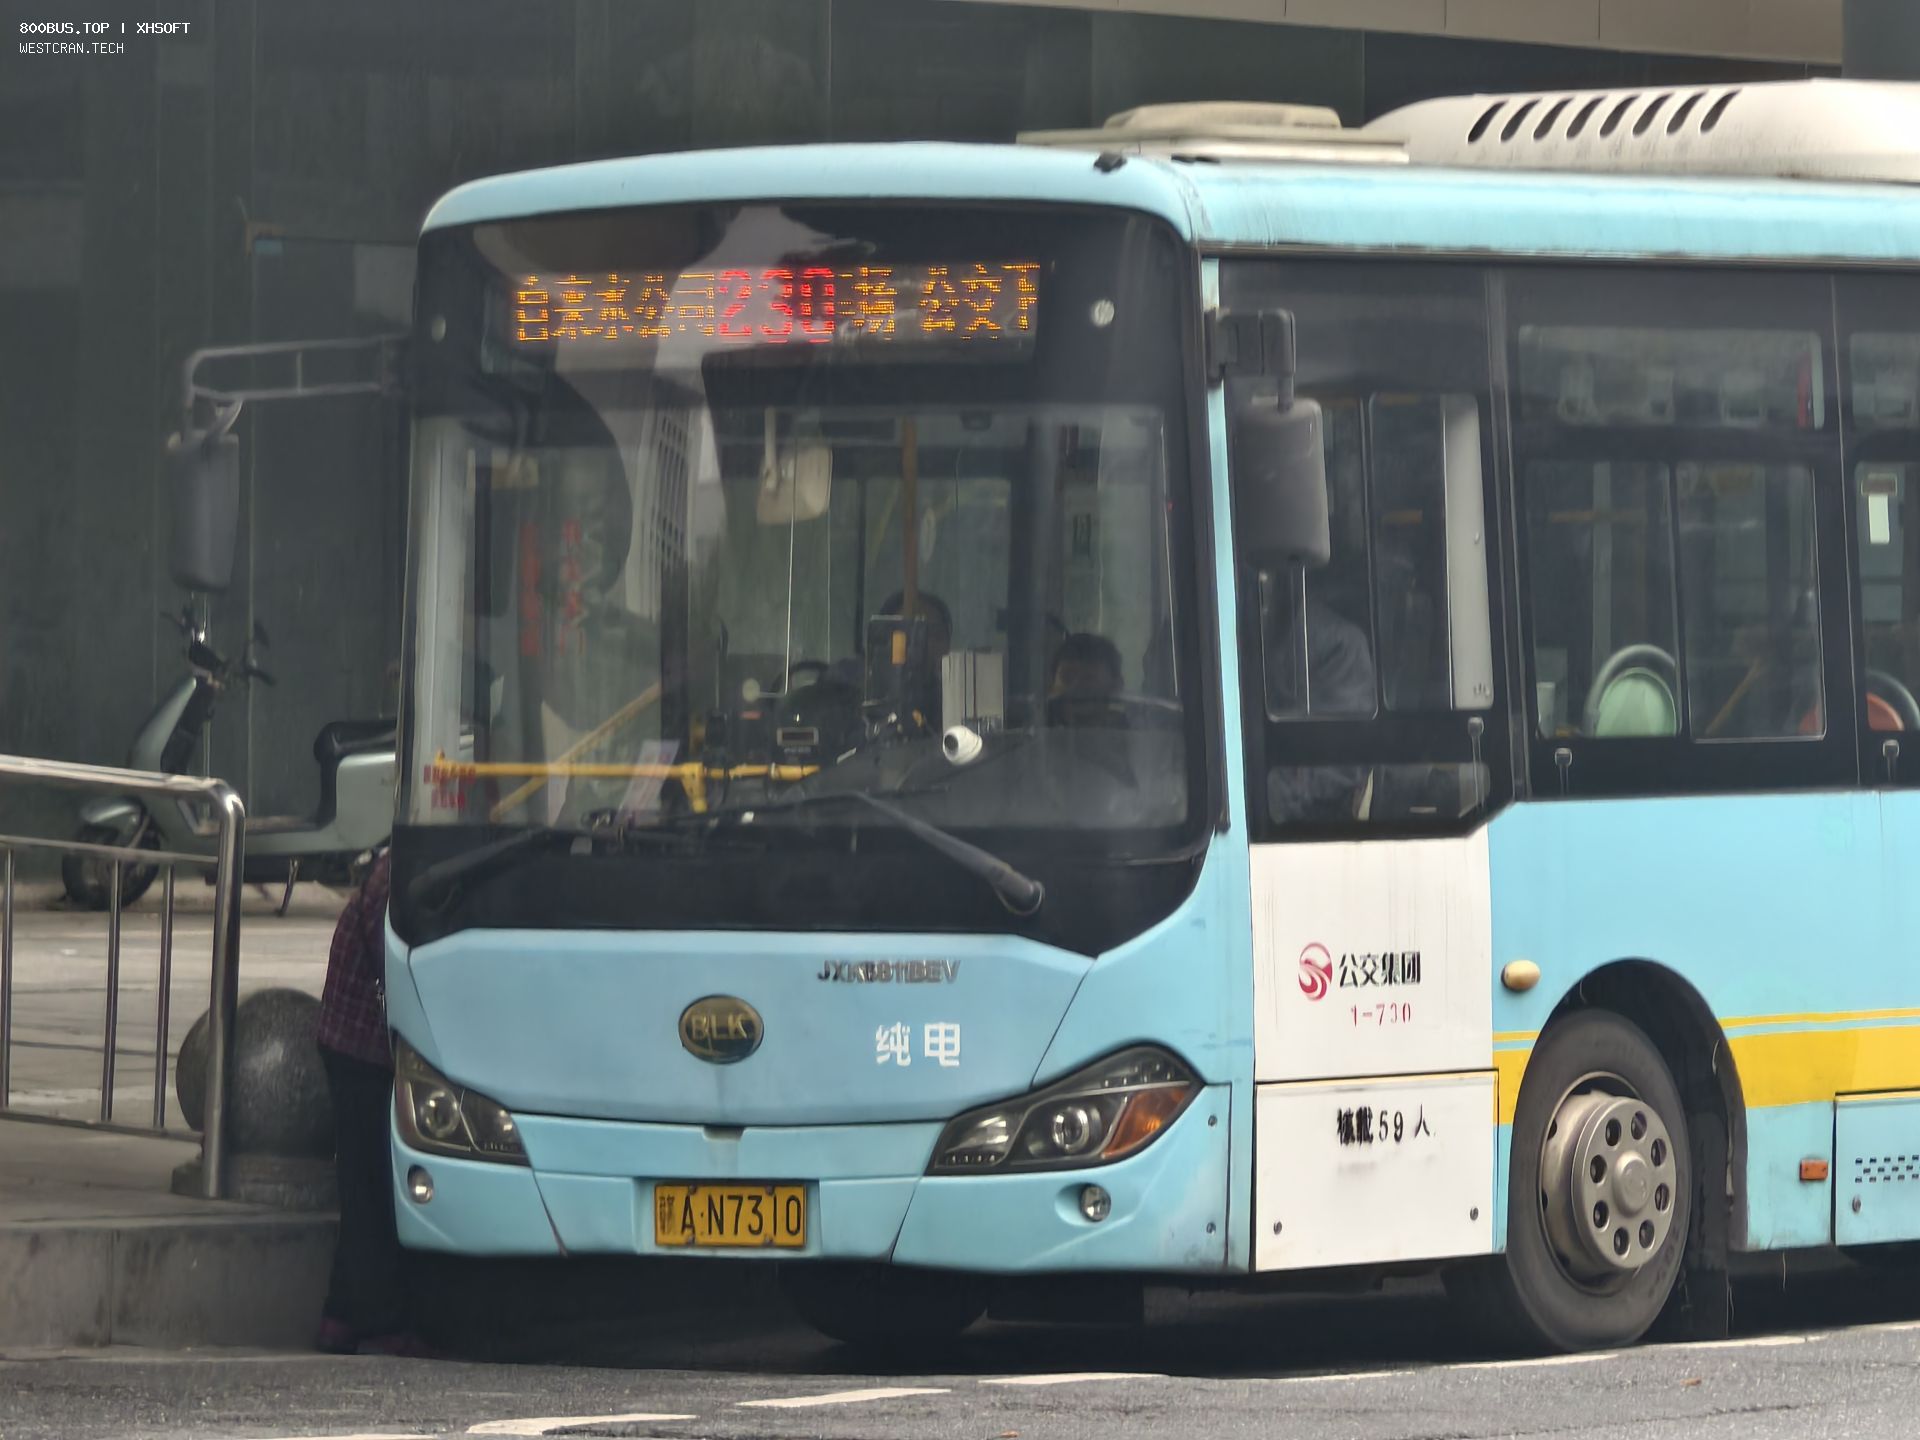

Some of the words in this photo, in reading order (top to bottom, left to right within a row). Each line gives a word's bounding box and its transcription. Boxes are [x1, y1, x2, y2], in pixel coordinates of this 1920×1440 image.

[718, 266, 836, 343] 230
[1339, 950, 1421, 988] 公交集团
[1351, 1002, 1411, 1028] 1-730
[875, 1021, 961, 1067] 纯电
